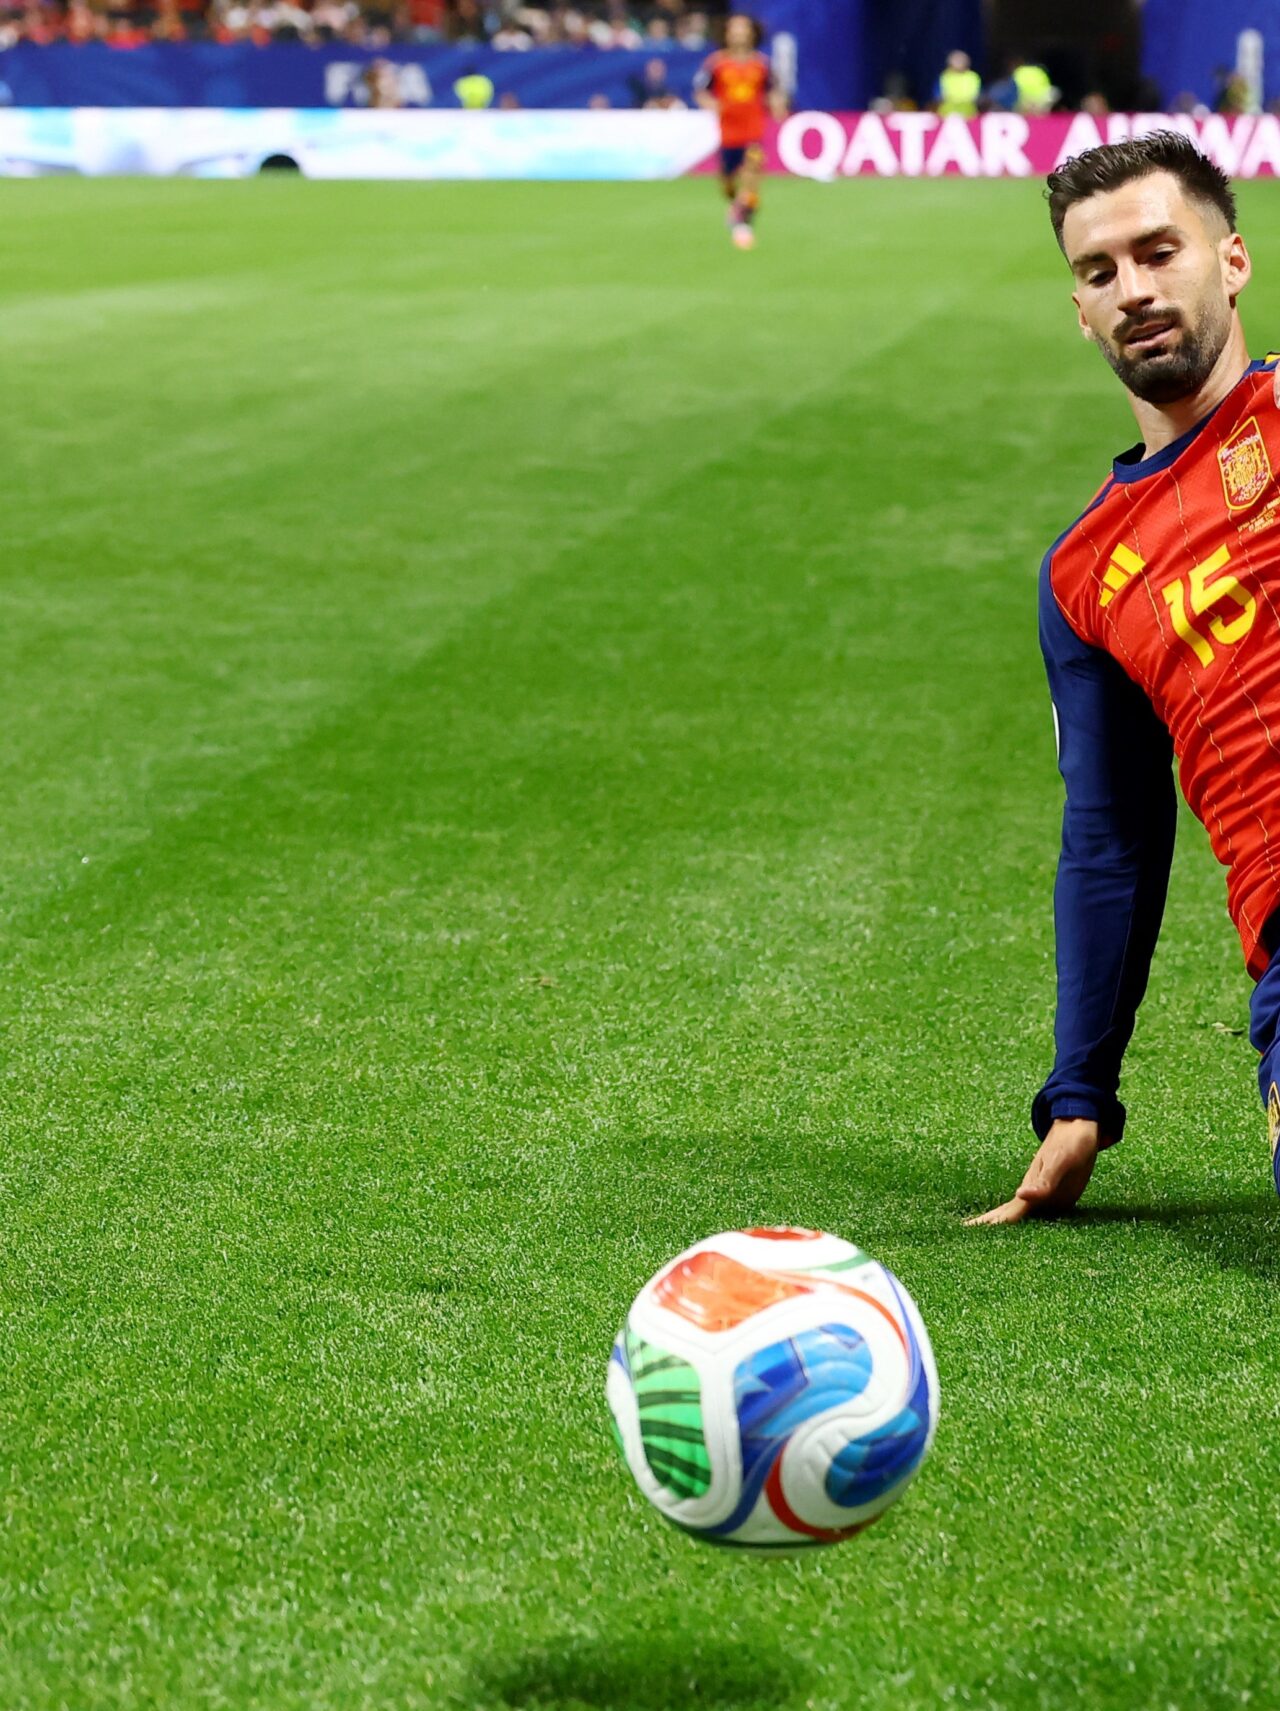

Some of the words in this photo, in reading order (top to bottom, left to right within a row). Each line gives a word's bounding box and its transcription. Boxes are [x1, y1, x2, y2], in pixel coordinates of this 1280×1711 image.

[325, 62, 431, 105] FIA
[777, 110, 1033, 182] QATAR
[1162, 543, 1256, 669] 15
